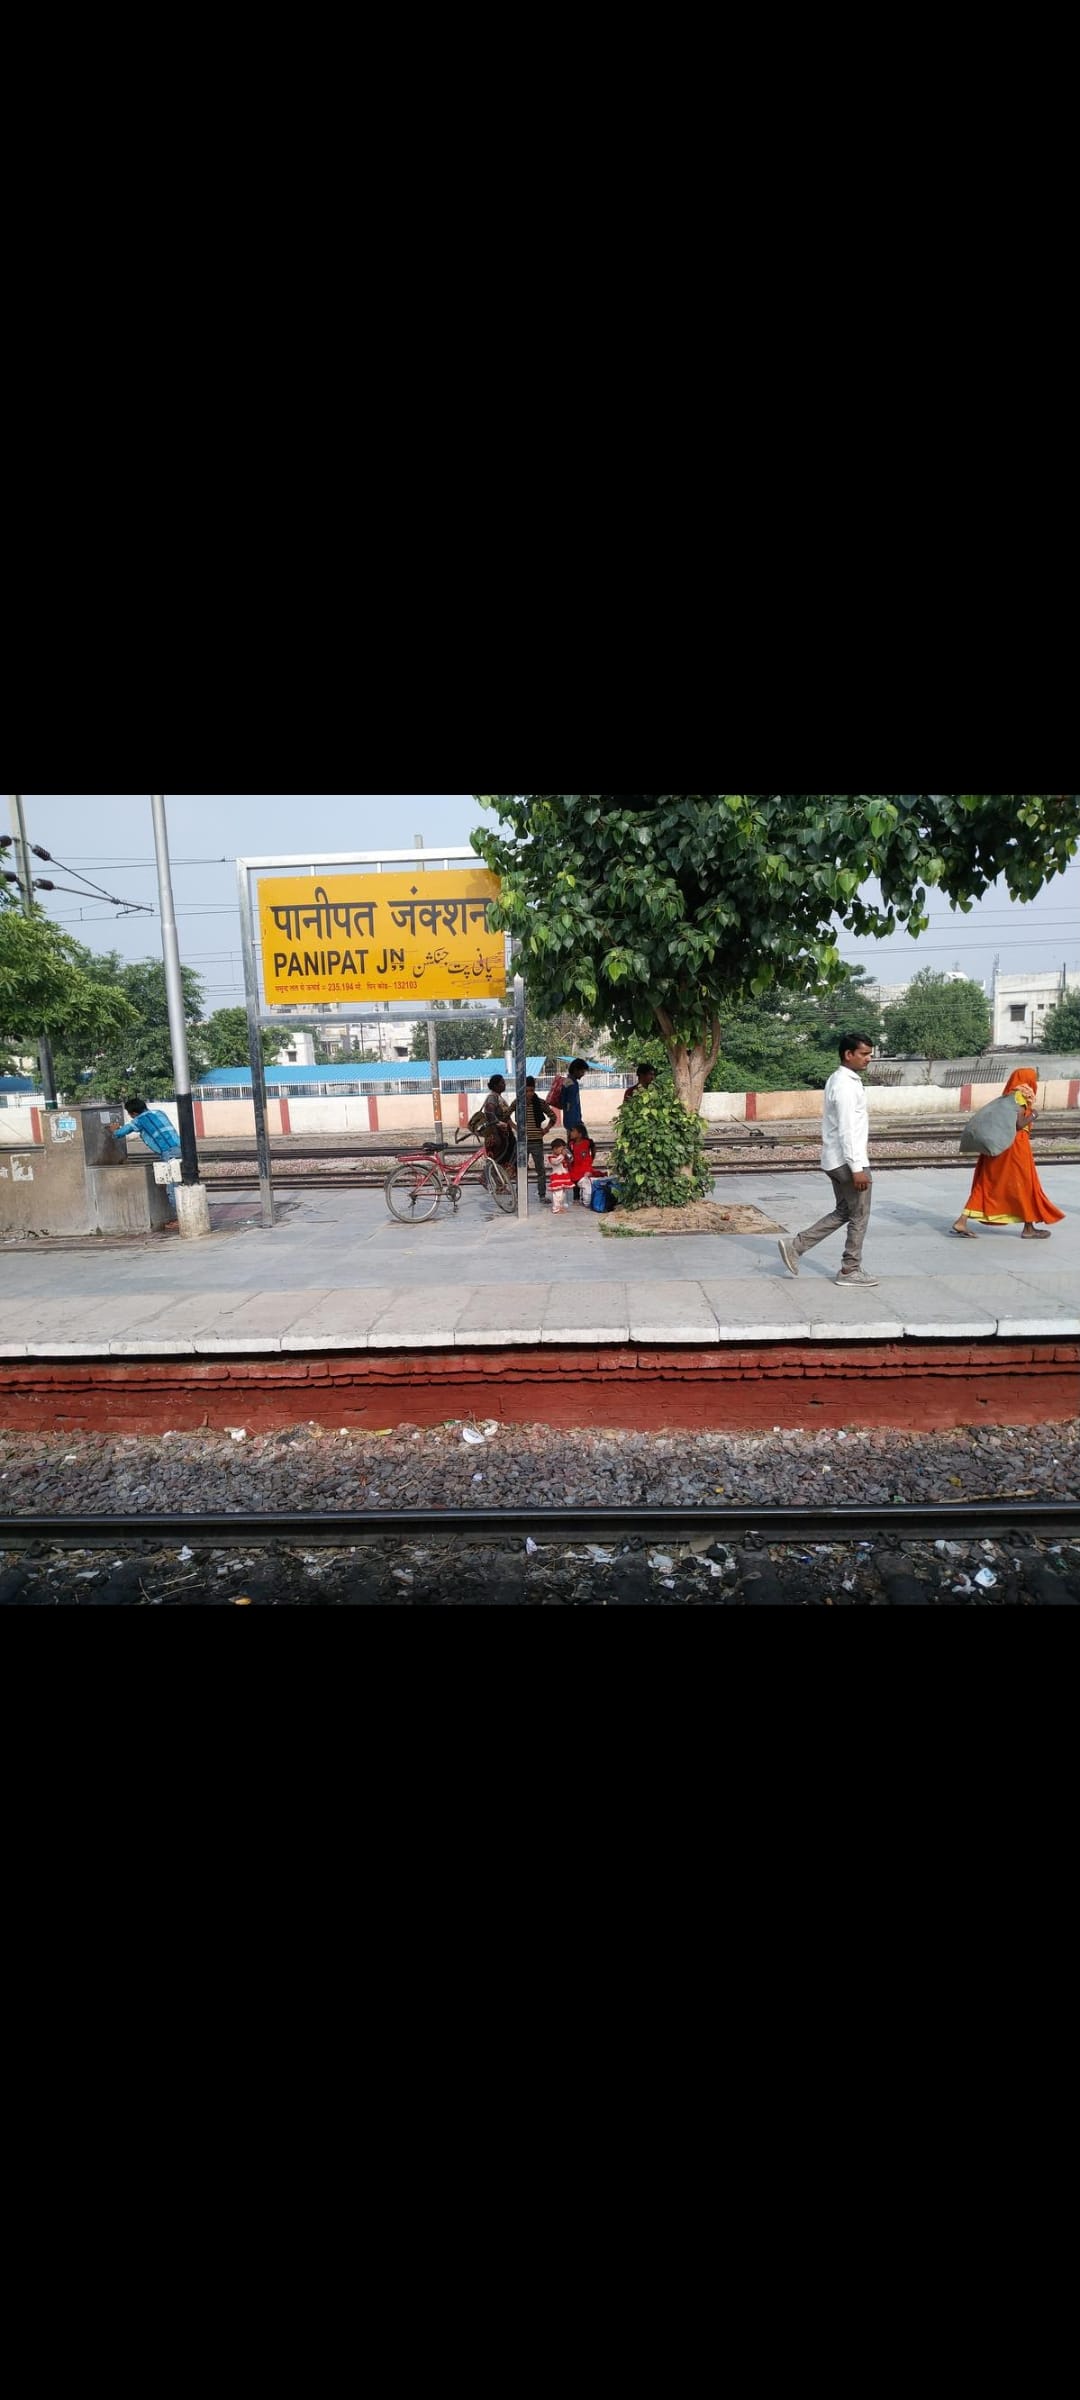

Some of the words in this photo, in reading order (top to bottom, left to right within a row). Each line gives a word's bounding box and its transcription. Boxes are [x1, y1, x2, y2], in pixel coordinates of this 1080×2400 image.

[270, 886, 378, 941] पानीपत
[388, 886, 493, 936] जंक्शन
[274, 949, 369, 977] PANIPAT
[394, 980, 418, 990] 132103
